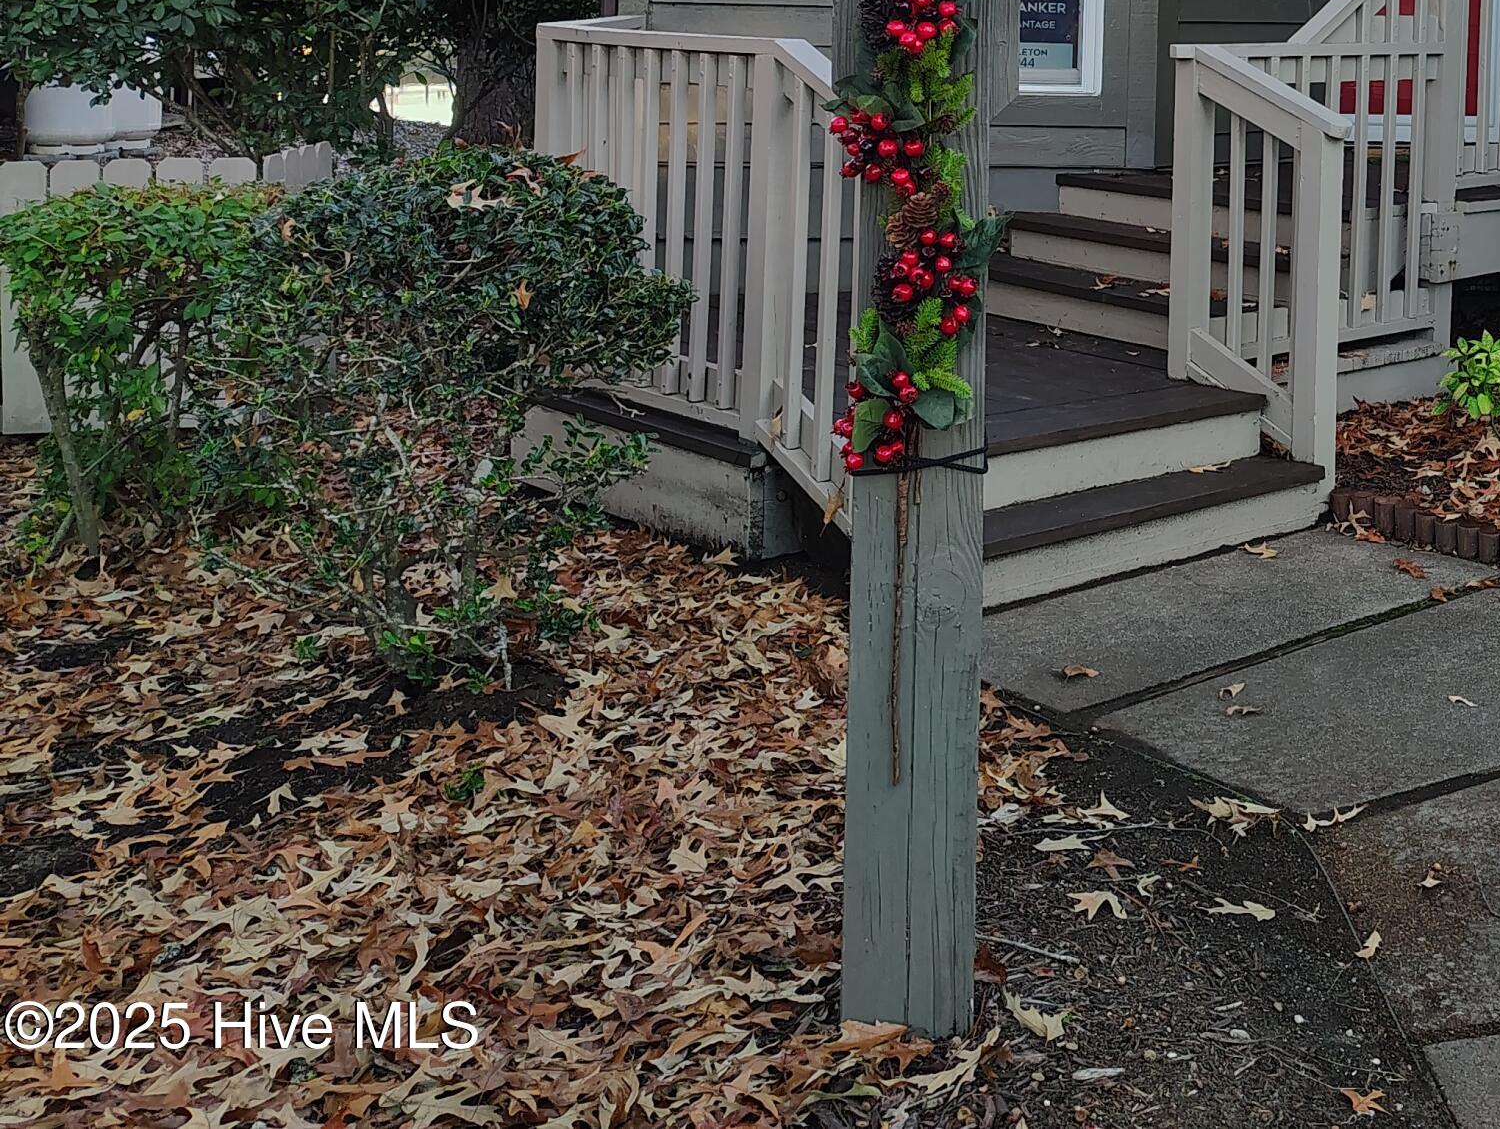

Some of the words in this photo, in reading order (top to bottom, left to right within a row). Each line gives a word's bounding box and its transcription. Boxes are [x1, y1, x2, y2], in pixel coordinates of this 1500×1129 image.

[1019, 1, 1066, 14] ANKER
[1020, 20, 1056, 29] NTAGE
[1019, 57, 1035, 68] 44
